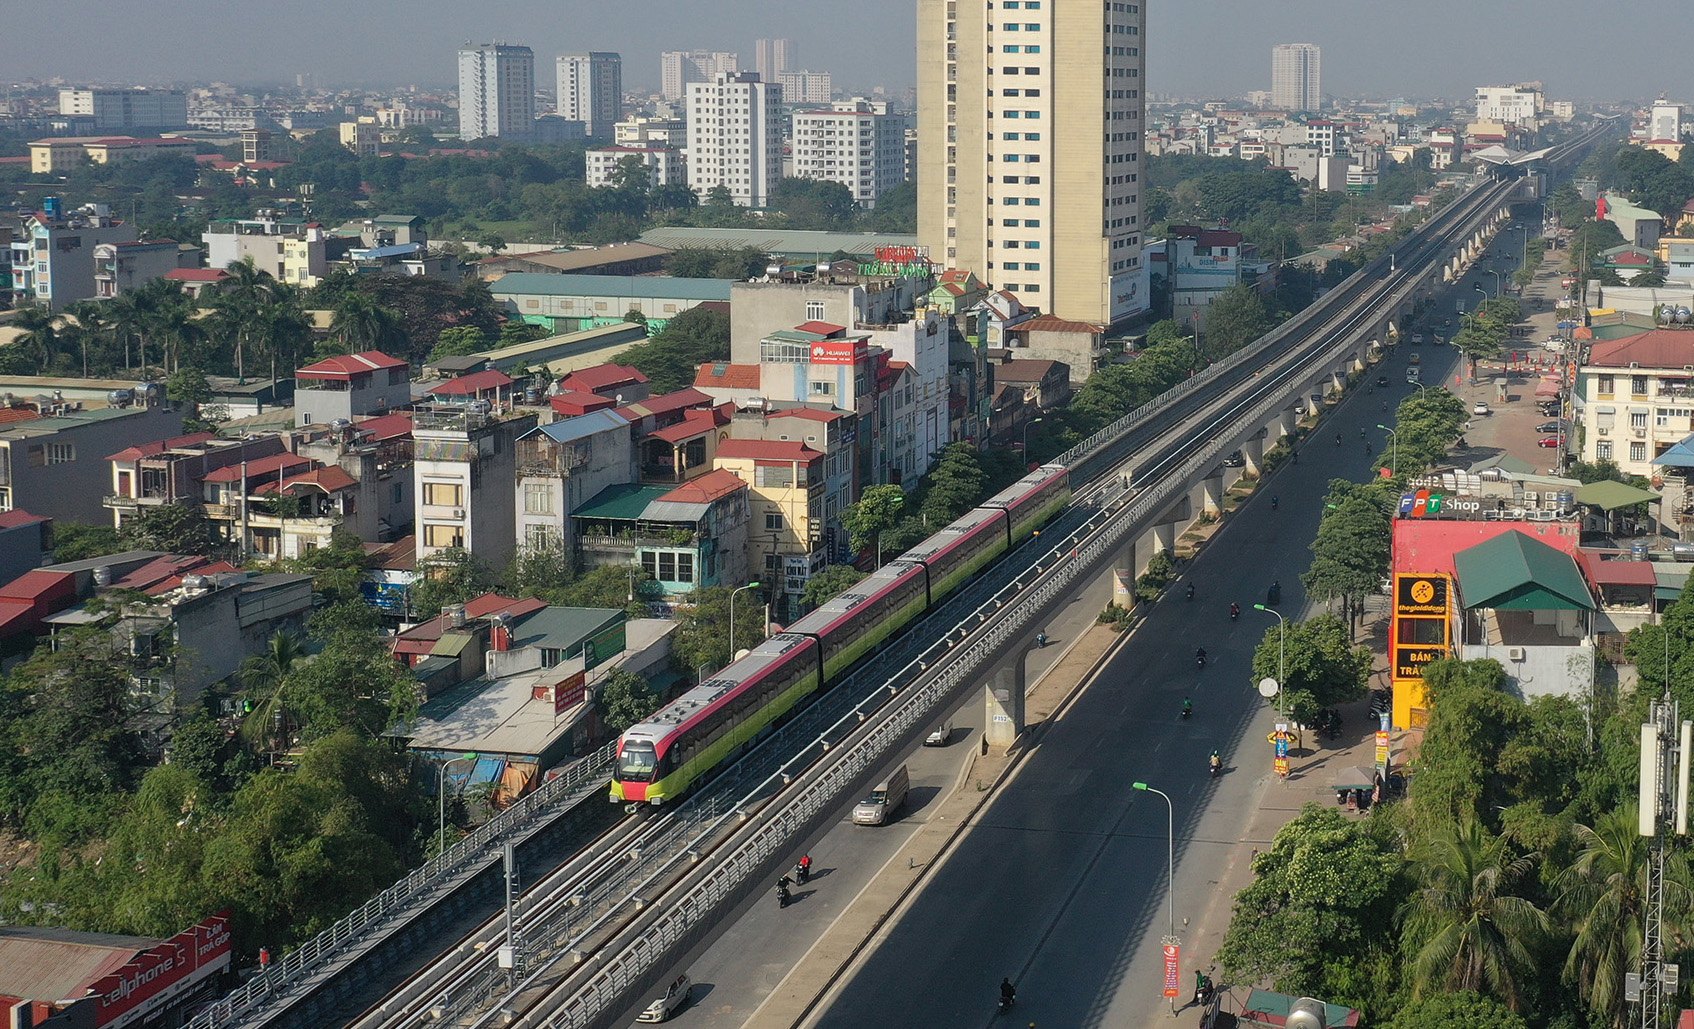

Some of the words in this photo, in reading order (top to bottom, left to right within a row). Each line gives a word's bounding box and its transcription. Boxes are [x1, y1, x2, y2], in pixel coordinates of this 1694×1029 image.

[1218, 217, 1229, 226] 39
[1446, 499, 1479, 513] Shop
[1410, 652, 1432, 662] BÁN
[1400, 664, 1419, 675] TRẢ
[101, 956, 173, 1008] cellphone
